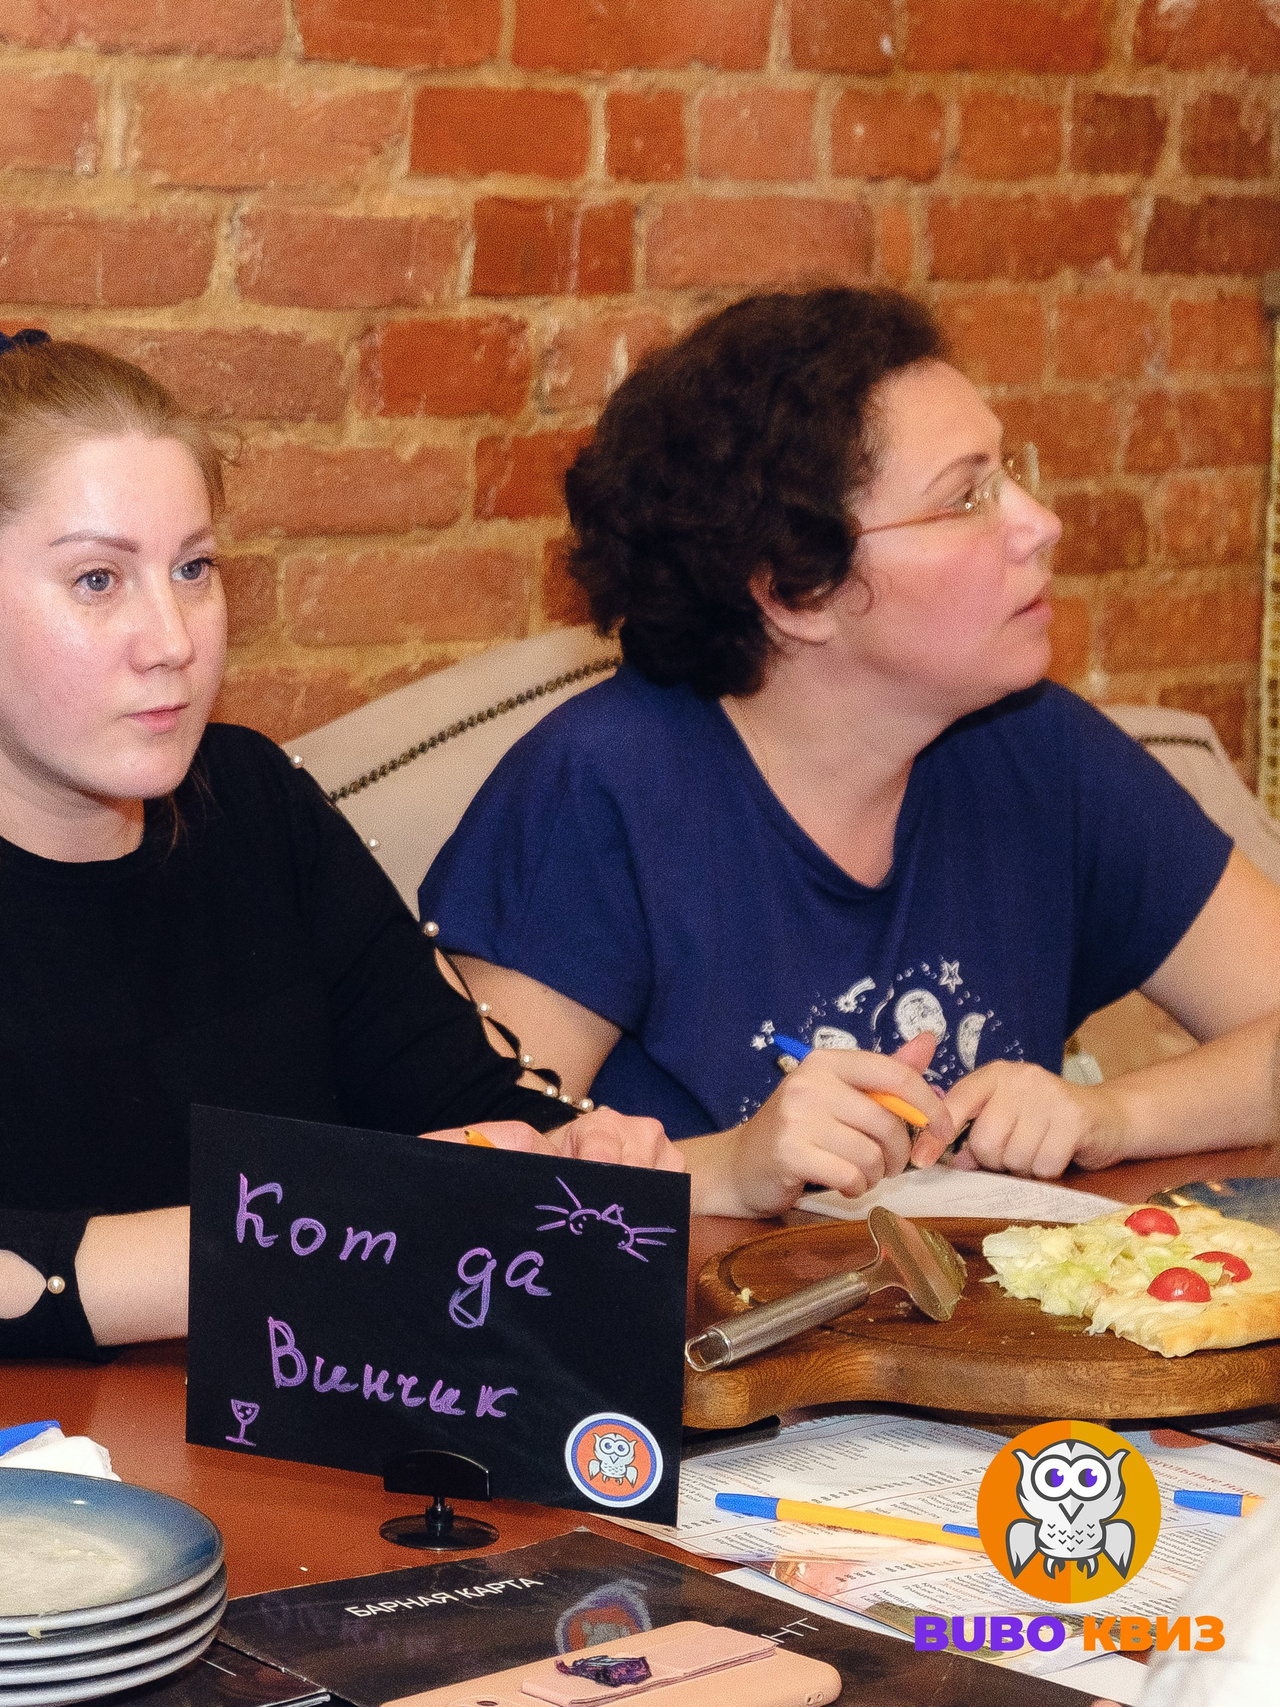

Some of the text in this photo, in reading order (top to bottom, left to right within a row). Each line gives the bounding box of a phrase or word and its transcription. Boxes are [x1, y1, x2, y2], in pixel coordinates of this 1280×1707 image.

[236, 1172, 398, 1265] Кот
[267, 1315, 519, 1418] Винчик
[344, 1577, 545, 1618] БАРНАЯ КАРТА
